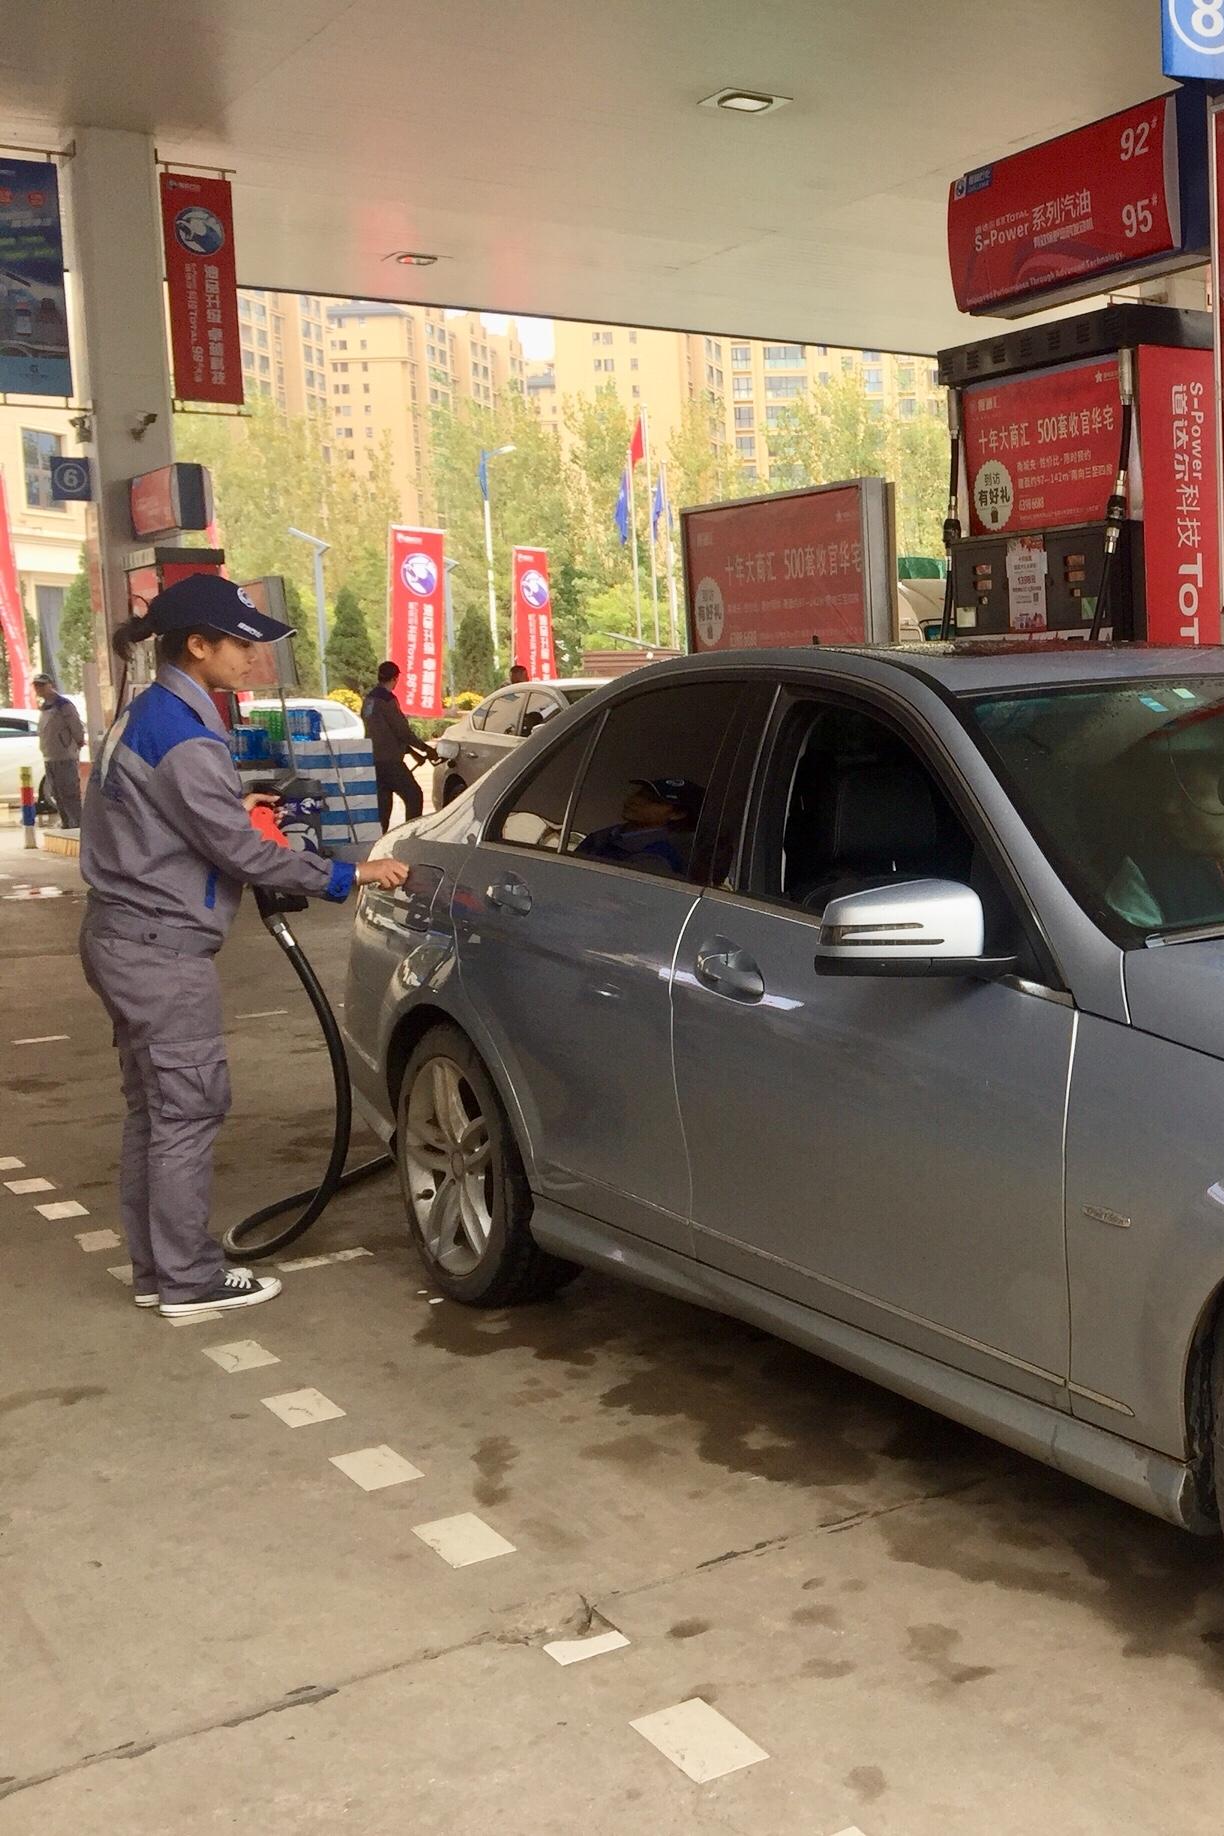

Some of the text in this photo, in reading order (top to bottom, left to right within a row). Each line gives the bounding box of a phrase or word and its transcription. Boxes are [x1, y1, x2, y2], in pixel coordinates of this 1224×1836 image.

[1191, 0, 1224, 37] 8
[1032, 187, 1091, 231] 系列汽油
[1121, 195, 1158, 238] 95#
[975, 223, 1029, 252] S-Power
[978, 422, 1030, 454] 十年大商汇
[1037, 404, 1113, 444] 500套收官华宅
[1189, 382, 1203, 480] S-Power
[64, 469, 78, 487] 6
[978, 486, 1010, 506] 有好礼
[984, 472, 1000, 486] 到访
[725, 541, 862, 585] 十年大商汇 500套收官华宅
